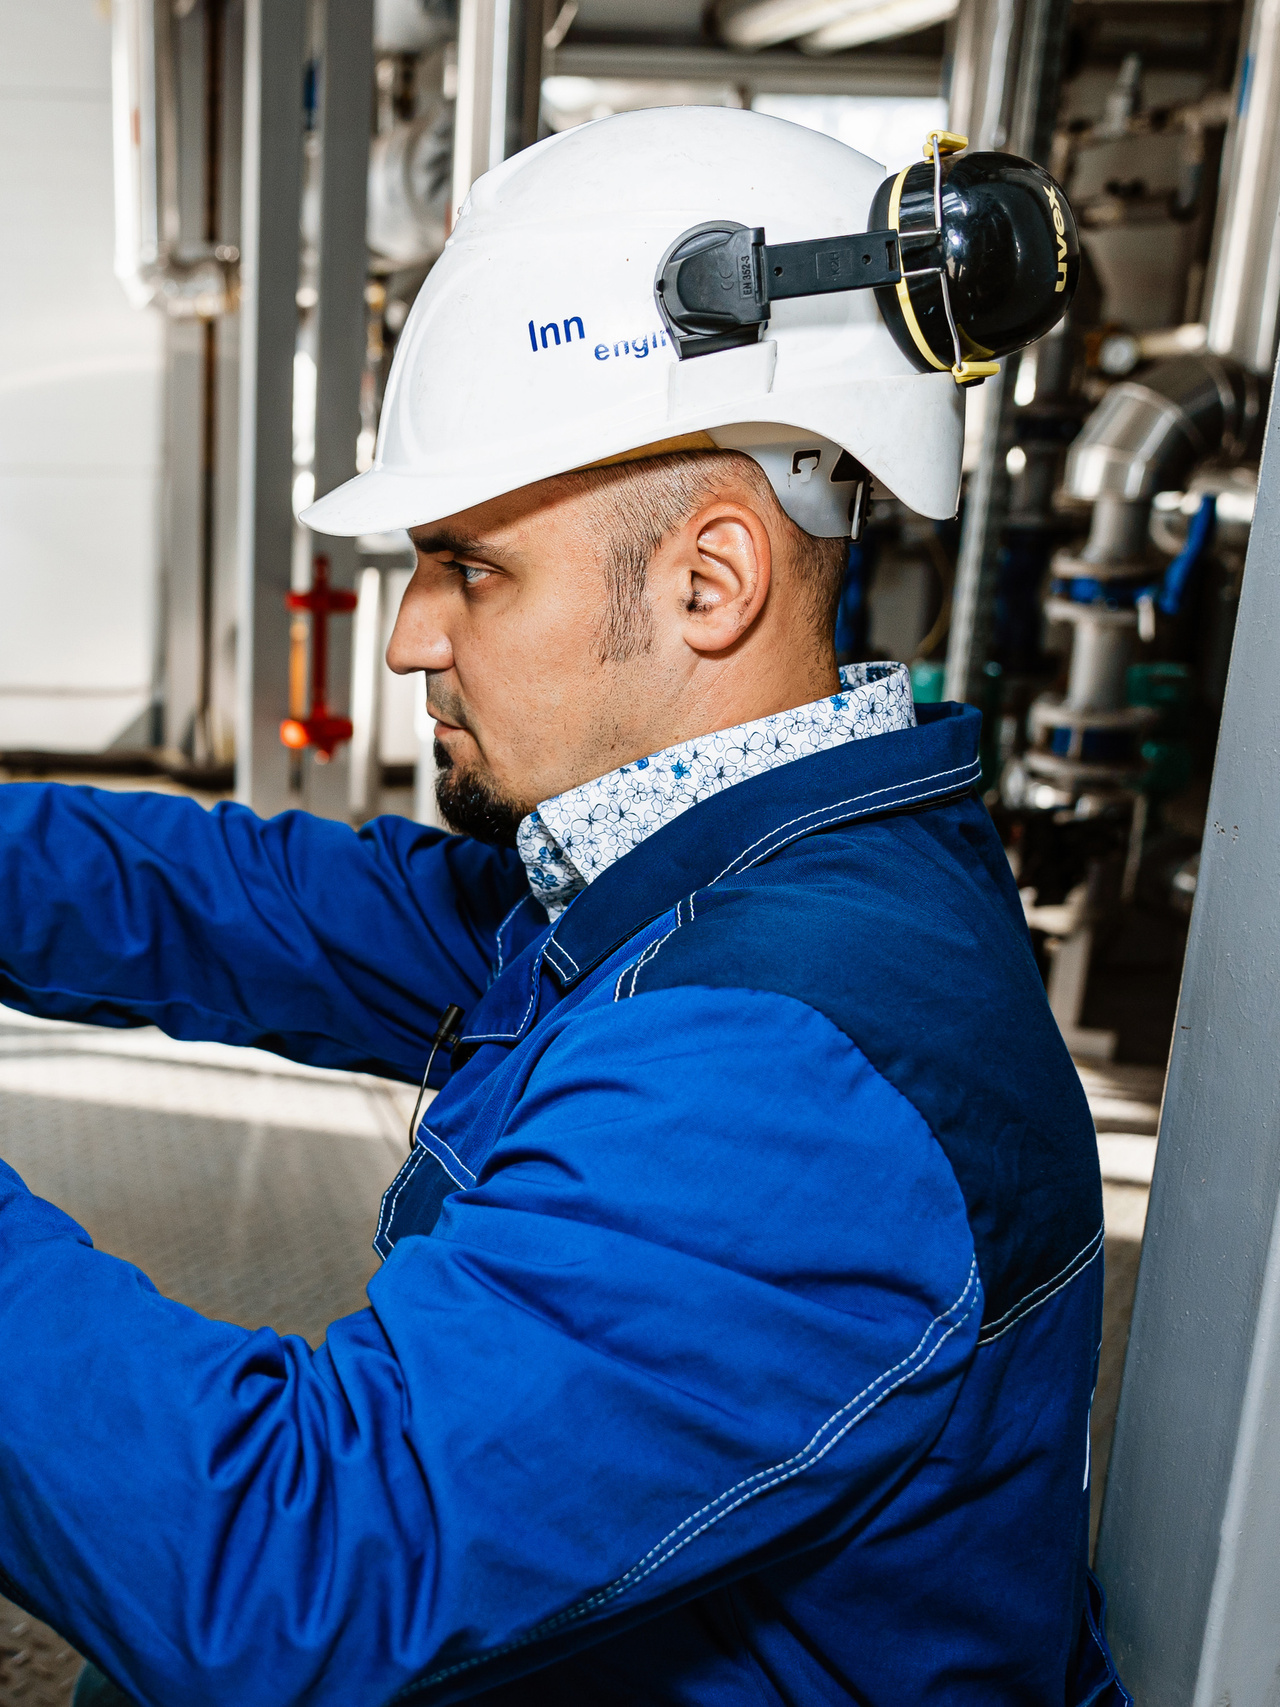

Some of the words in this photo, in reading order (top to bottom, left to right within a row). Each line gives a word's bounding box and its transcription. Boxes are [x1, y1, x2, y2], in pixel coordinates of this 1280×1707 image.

[1042, 185, 1068, 293] uvex
[741, 255, 752, 281] 352-3
[742, 282, 752, 296] EN
[528, 315, 586, 352] Inn
